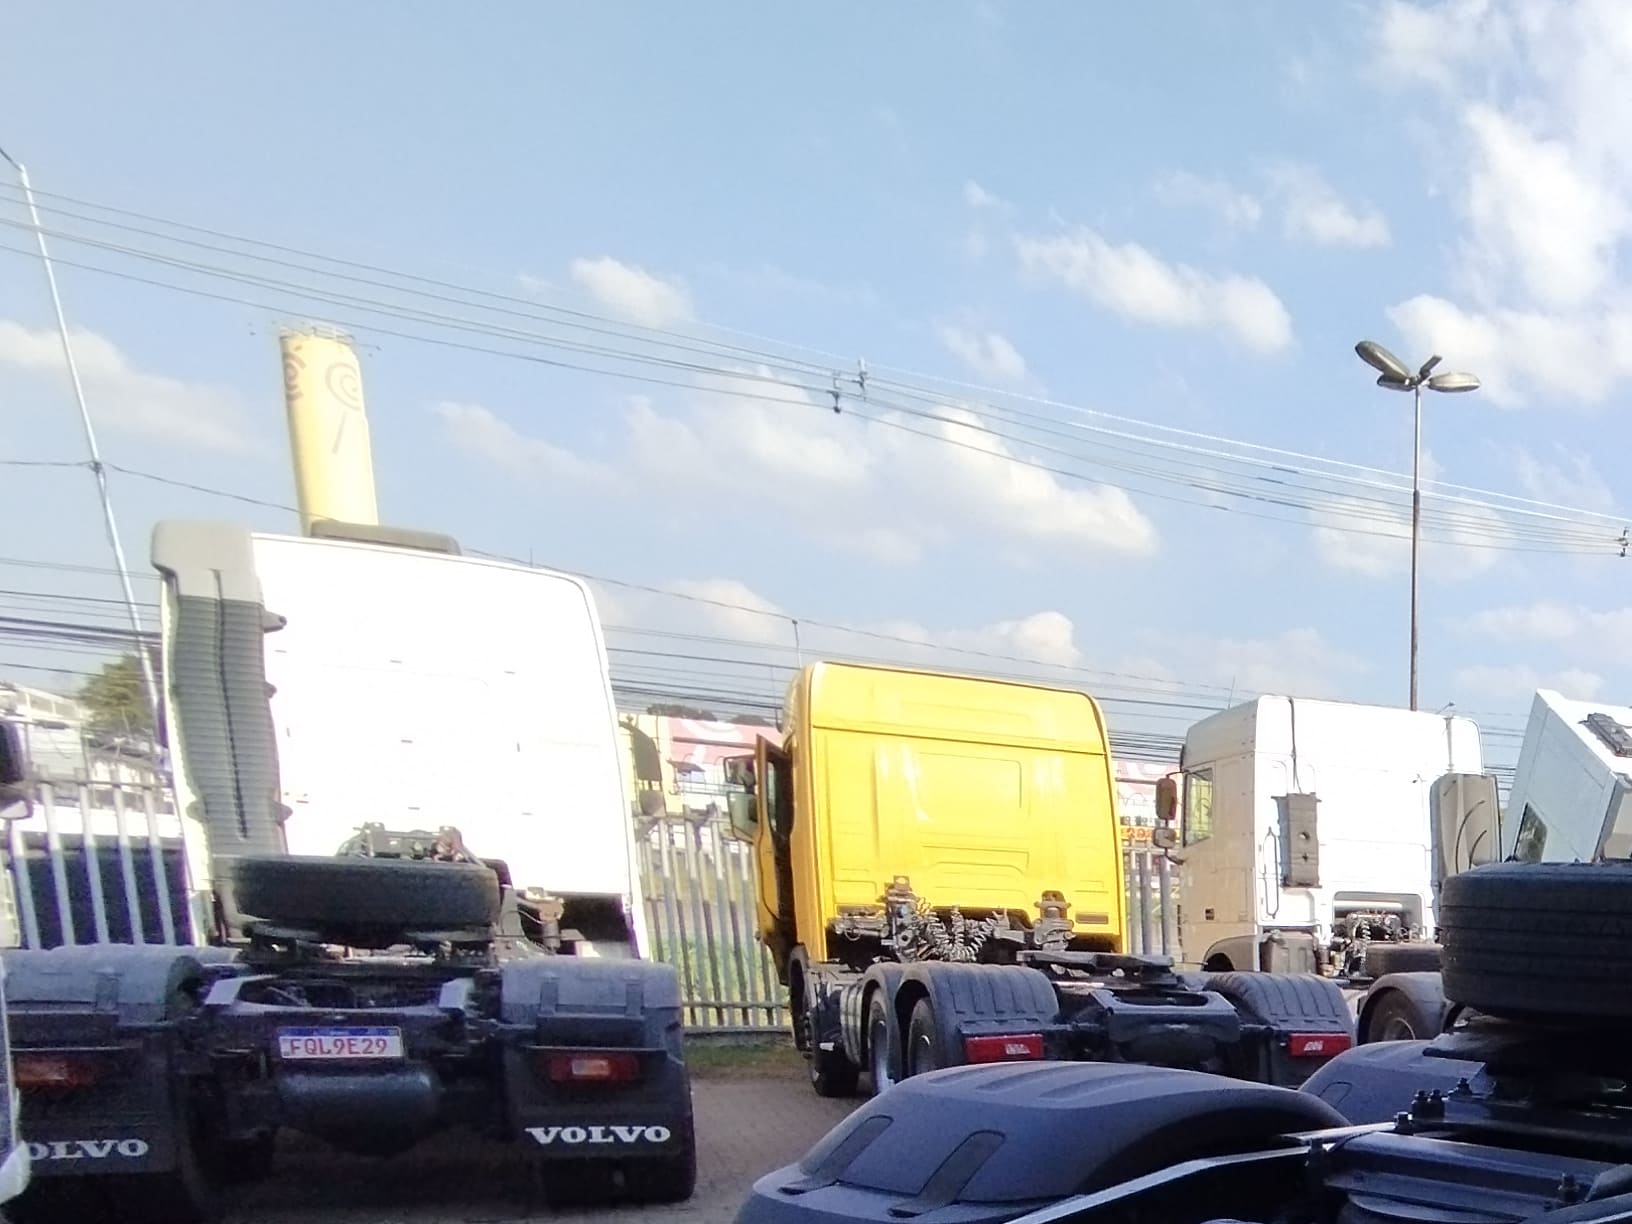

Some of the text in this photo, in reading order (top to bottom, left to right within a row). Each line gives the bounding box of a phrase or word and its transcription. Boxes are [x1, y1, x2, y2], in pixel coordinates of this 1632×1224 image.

[290, 1038, 388, 1056] FQL9E29
[525, 1126, 671, 1144] VOLVO
[26, 1139, 149, 1160] OLVO
